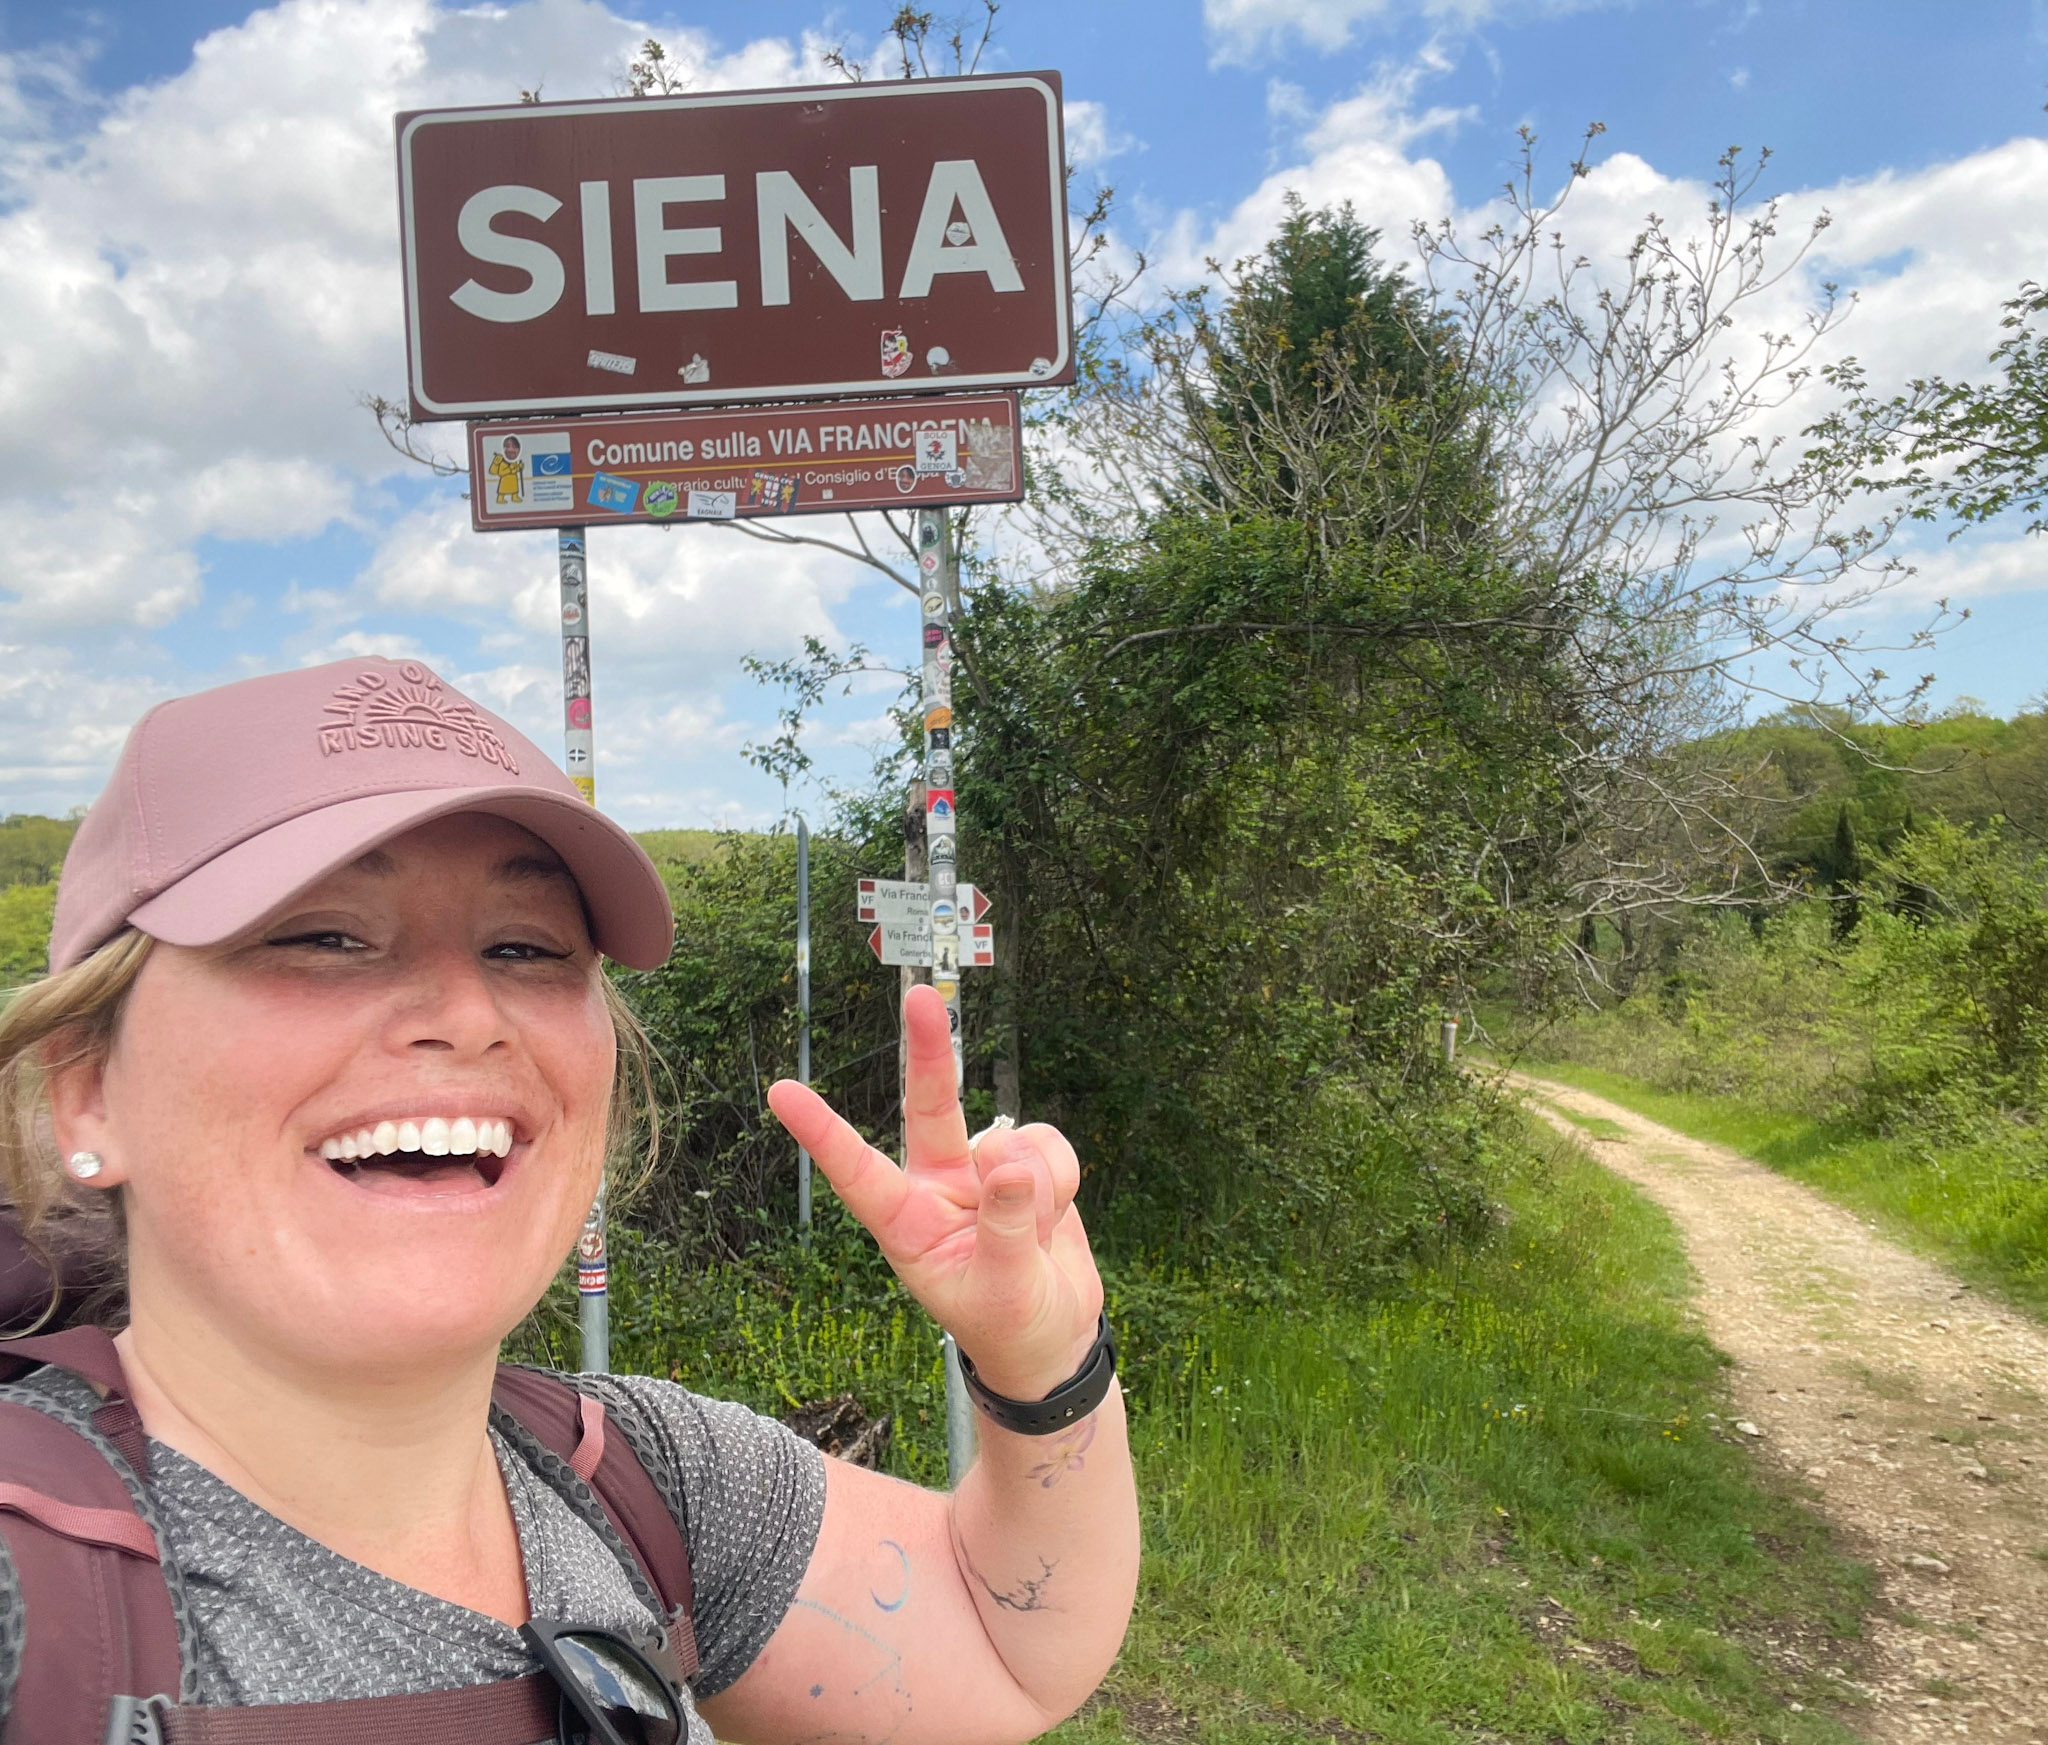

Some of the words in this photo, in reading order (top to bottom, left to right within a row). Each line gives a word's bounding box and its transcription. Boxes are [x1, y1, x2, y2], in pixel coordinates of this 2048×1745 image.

[449, 159, 1025, 323] SIENA
[587, 437, 695, 466] Comune
[700, 431, 762, 462] sulla
[767, 427, 813, 456] VIA
[920, 462, 952, 470] GENOA
[805, 468, 871, 487] Consiglio
[400, 664, 442, 692] OF
[319, 722, 447, 757] RISING
[456, 733, 520, 775] SUN
[861, 895, 874, 905] VF
[880, 887, 897, 899] Via
[887, 930, 901, 940] Via
[975, 940, 988, 949] VF
